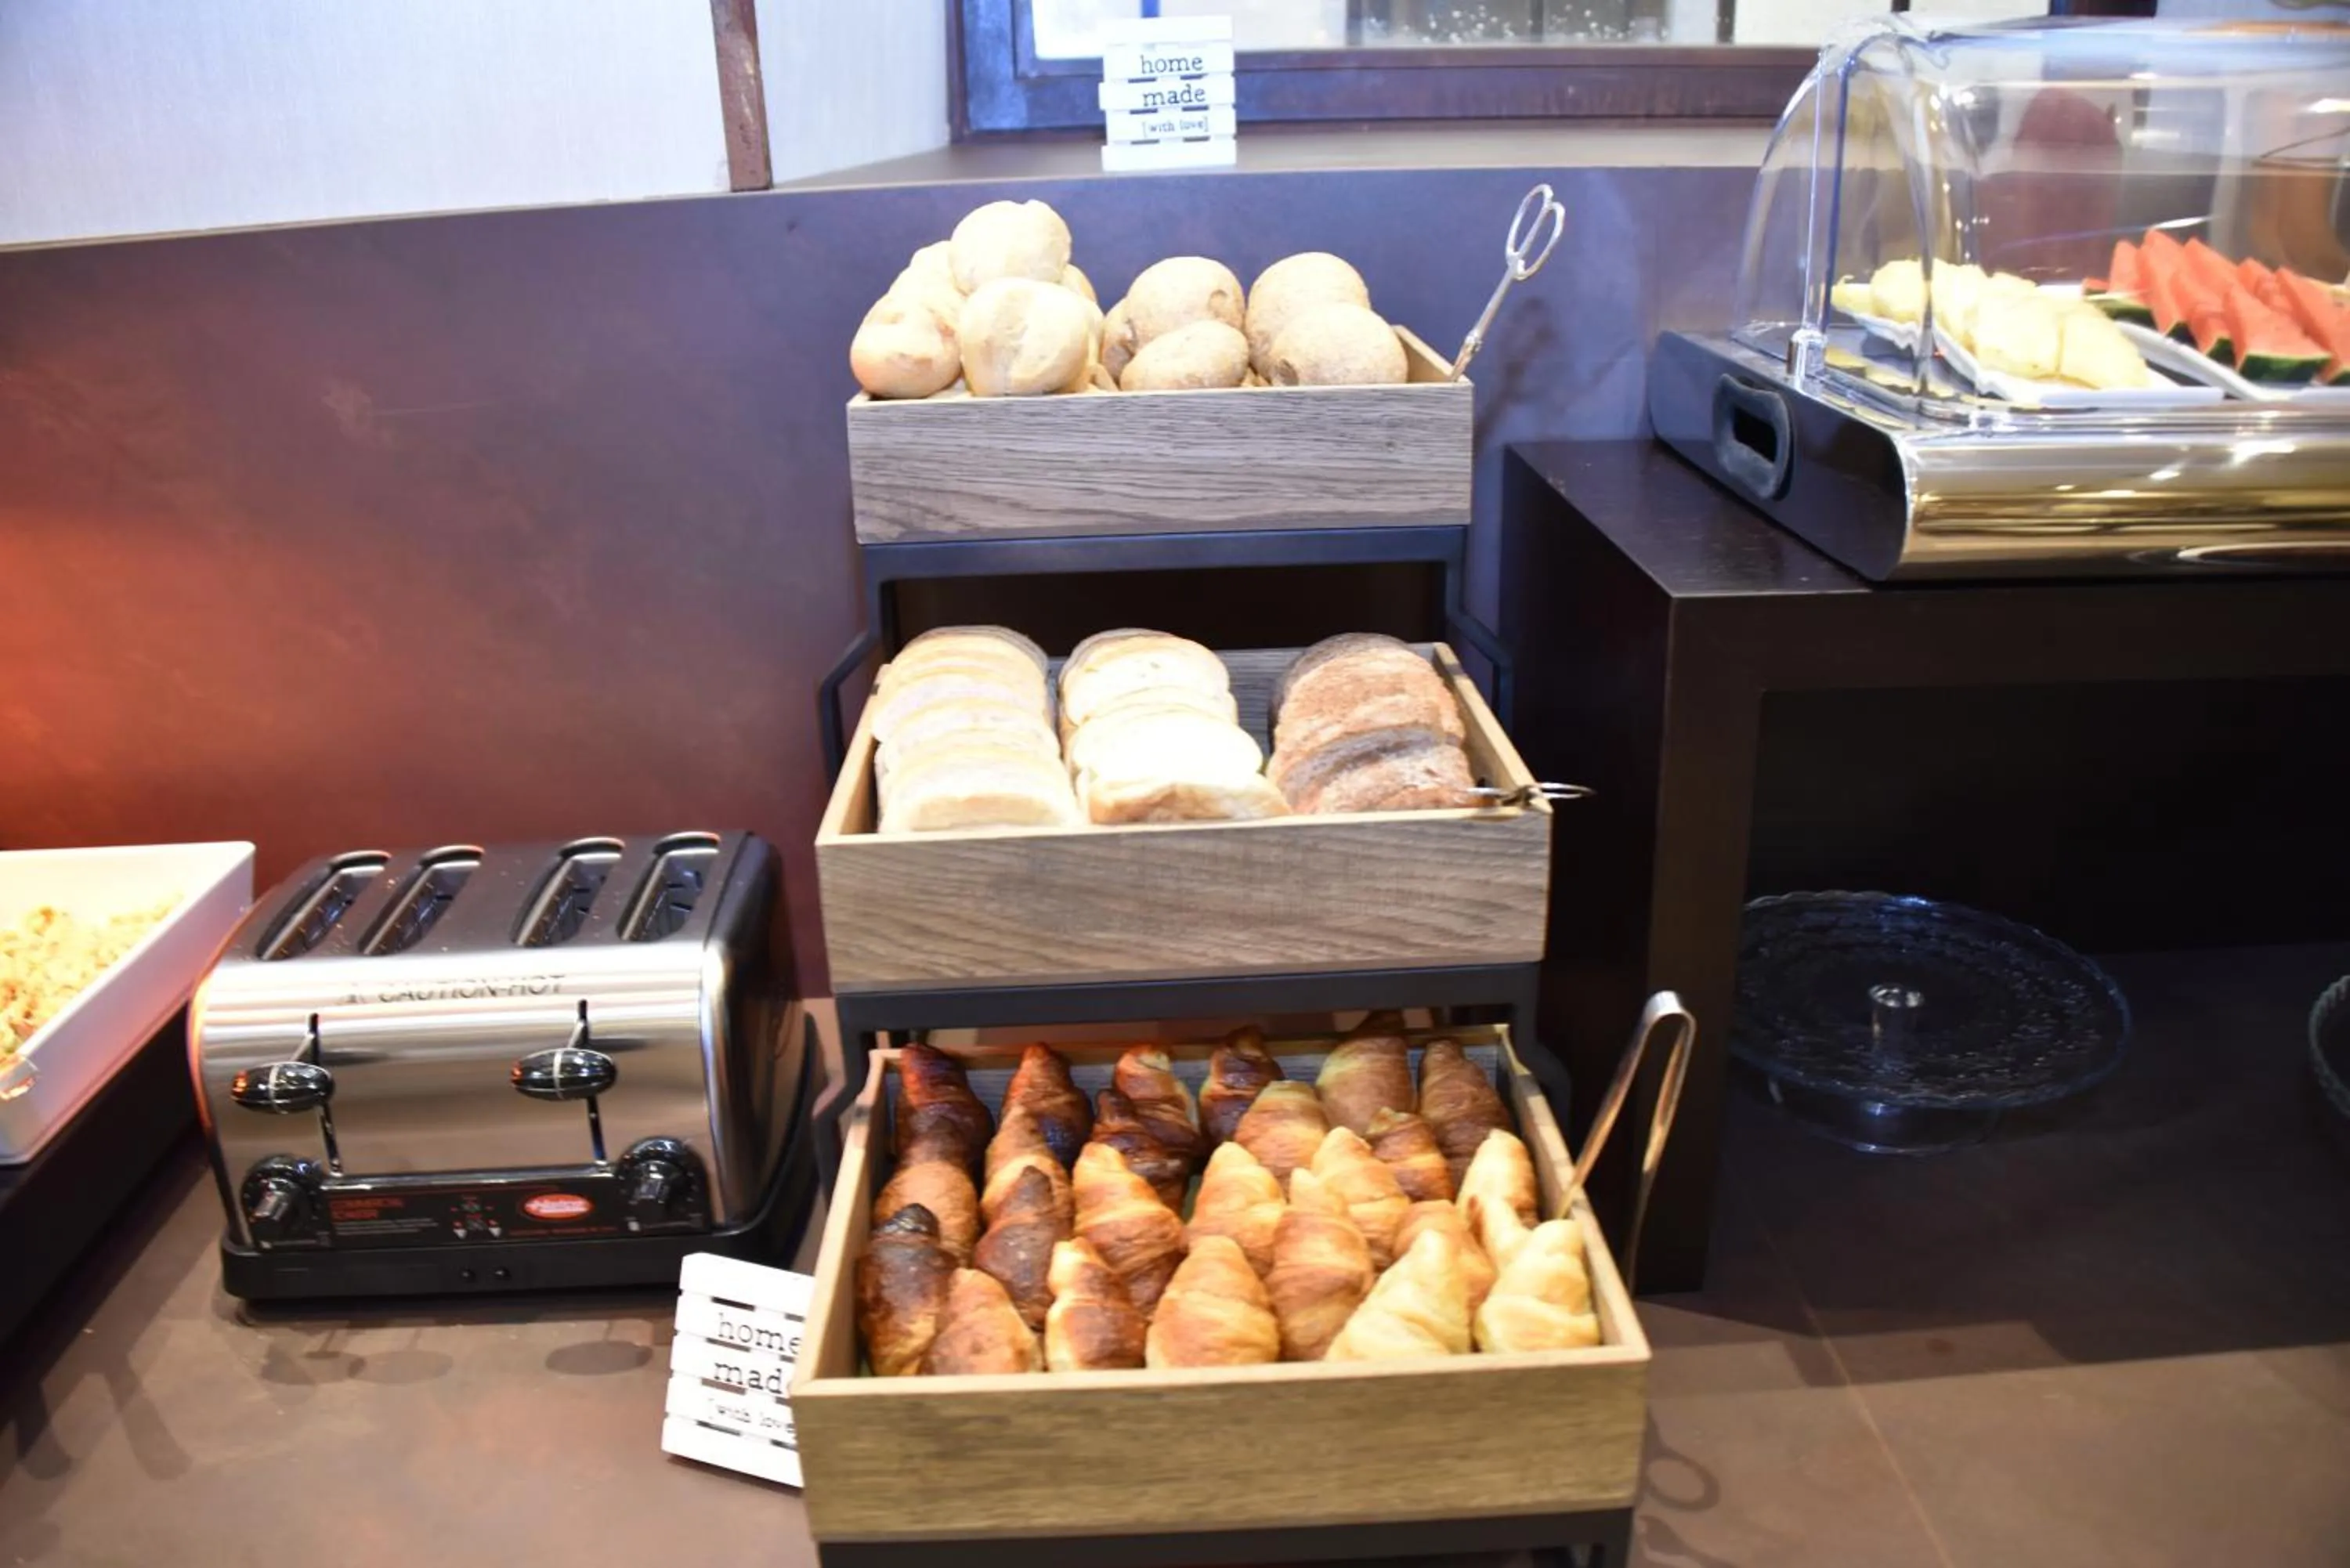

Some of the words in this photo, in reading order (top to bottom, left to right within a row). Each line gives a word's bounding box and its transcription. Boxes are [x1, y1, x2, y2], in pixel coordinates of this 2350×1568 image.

[1141, 55, 1203, 74] home
[1142, 83, 1206, 107] made
[718, 1312, 803, 1355] home
[714, 1361, 783, 1395] mad
